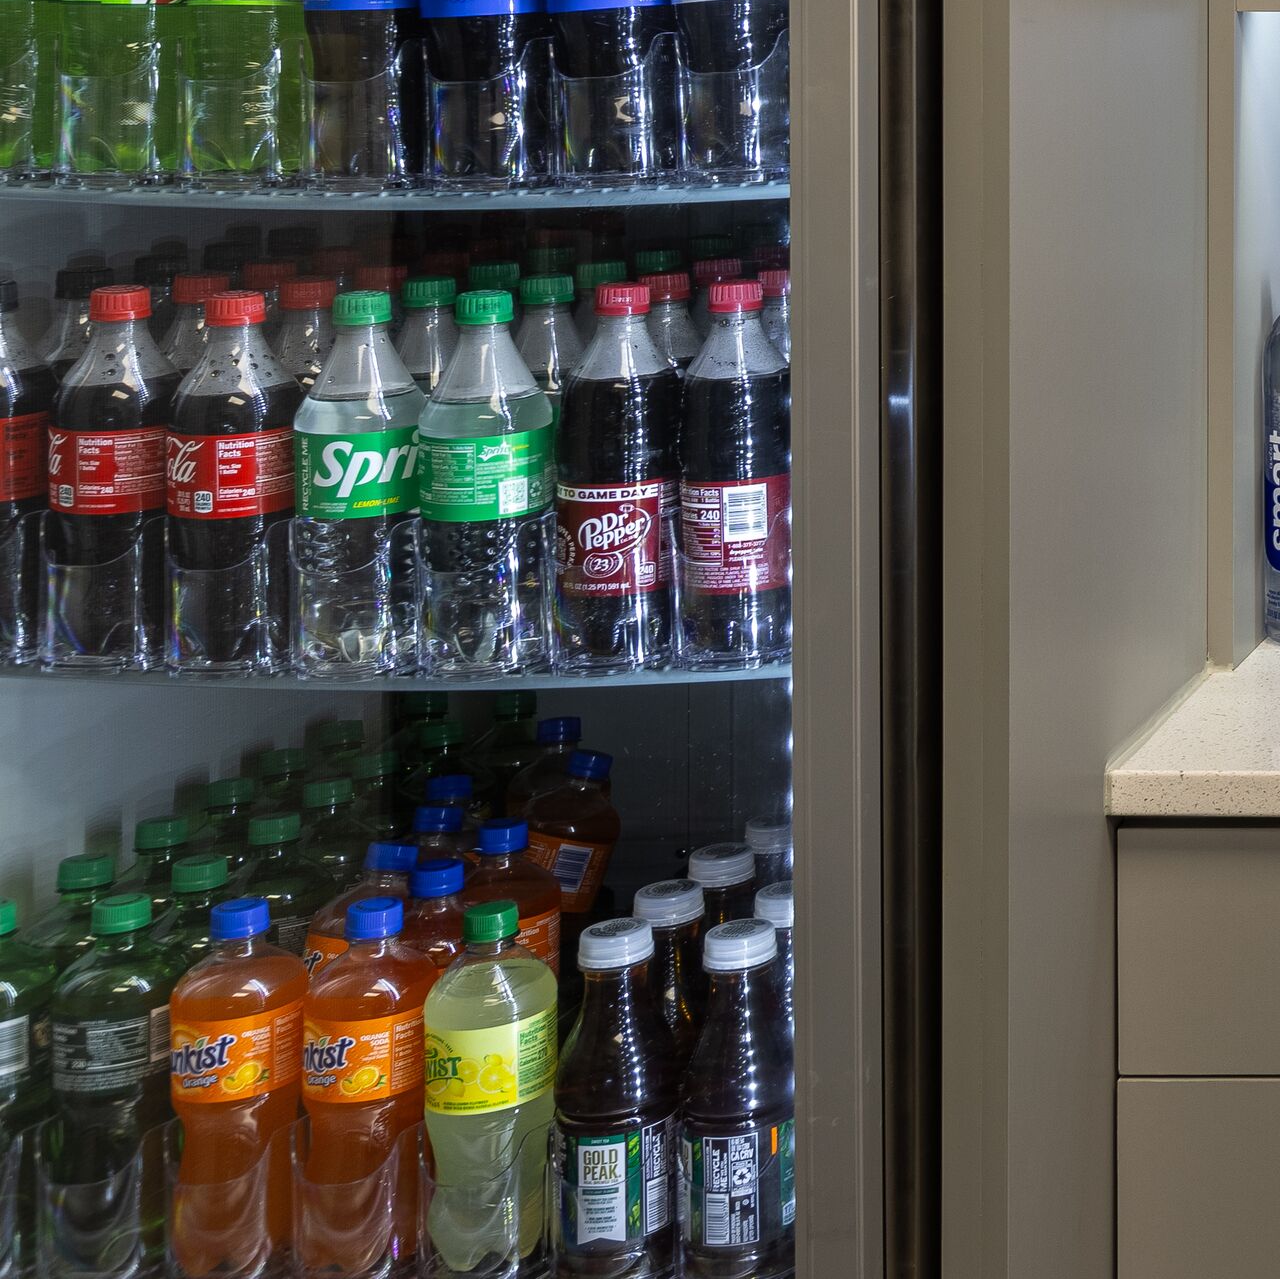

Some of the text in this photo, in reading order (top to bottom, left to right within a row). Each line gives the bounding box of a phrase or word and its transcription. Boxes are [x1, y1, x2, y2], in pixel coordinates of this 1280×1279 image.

[78, 438, 113, 447] Nutrition
[219, 441, 254, 450] Nutrition
[303, 437, 309, 456] ME
[78, 446, 101, 454] Facts
[219, 450, 241, 458] Facts
[195, 493, 211, 502] 240
[243, 488, 256, 496] 240
[564, 488, 648, 499] TO GAME DAY
[701, 488, 720, 497] Facts
[353, 496, 400, 509] LEMON-LIME
[701, 510, 720, 520] 240
[602, 512, 629, 531] Dr
[579, 518, 645, 550] Pepper
[593, 558, 609, 570] 23
[242, 1025, 272, 1039] ORANGE
[360, 1031, 390, 1043] ORANGE
[251, 1034, 272, 1045] SODA
[369, 1039, 390, 1048] SODA
[182, 1074, 218, 1089] Orange
[583, 1149, 618, 1165] GOLD
[583, 1165, 618, 1180] PEAK
[712, 1149, 720, 1192] RECYCLE
